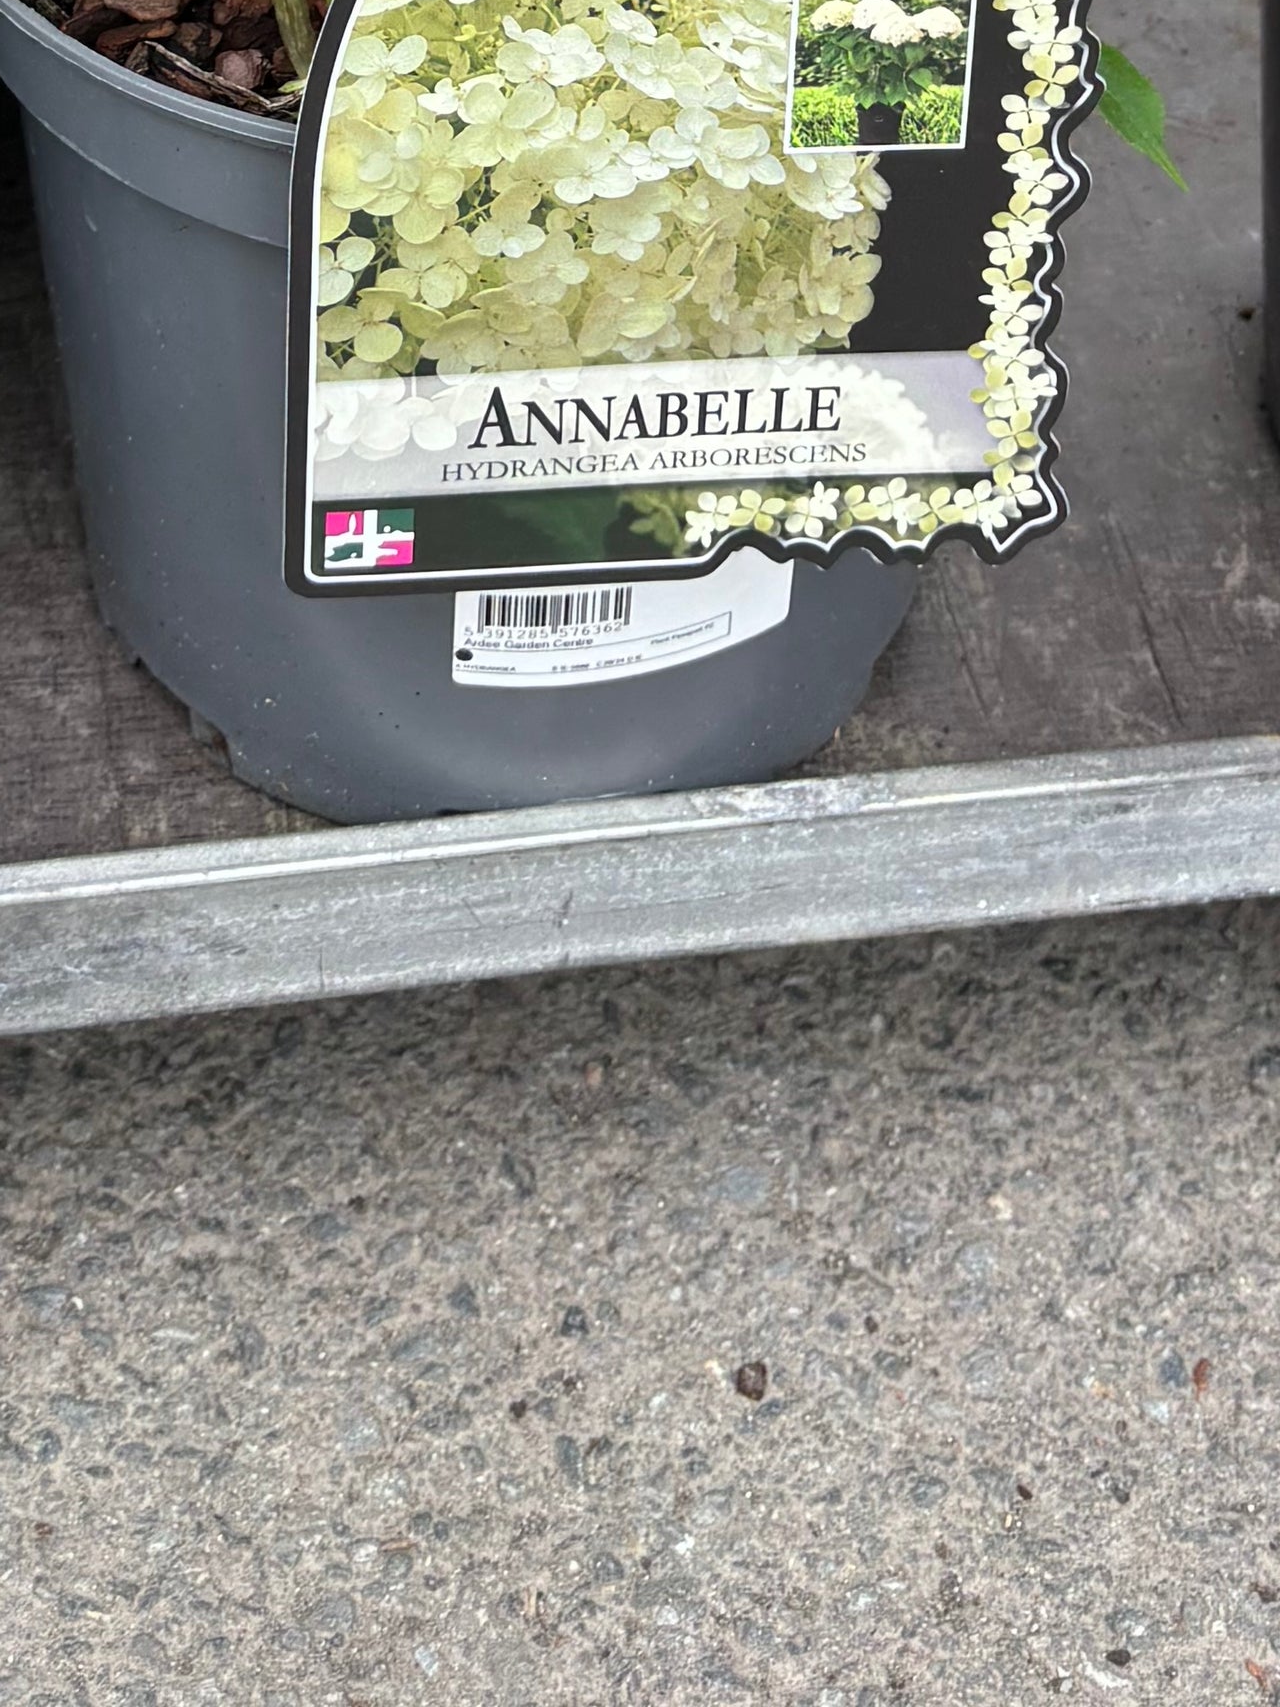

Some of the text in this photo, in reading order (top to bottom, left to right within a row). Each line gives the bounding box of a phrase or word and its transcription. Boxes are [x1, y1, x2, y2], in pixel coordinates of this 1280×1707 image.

[467, 385, 842, 449] ANNABELLE
[440, 442, 867, 483] HYDRANGEA ARBORESCENS
[485, 628, 549, 640] 391285
[558, 621, 624, 638] 576362
[503, 639, 550, 650] Garden
